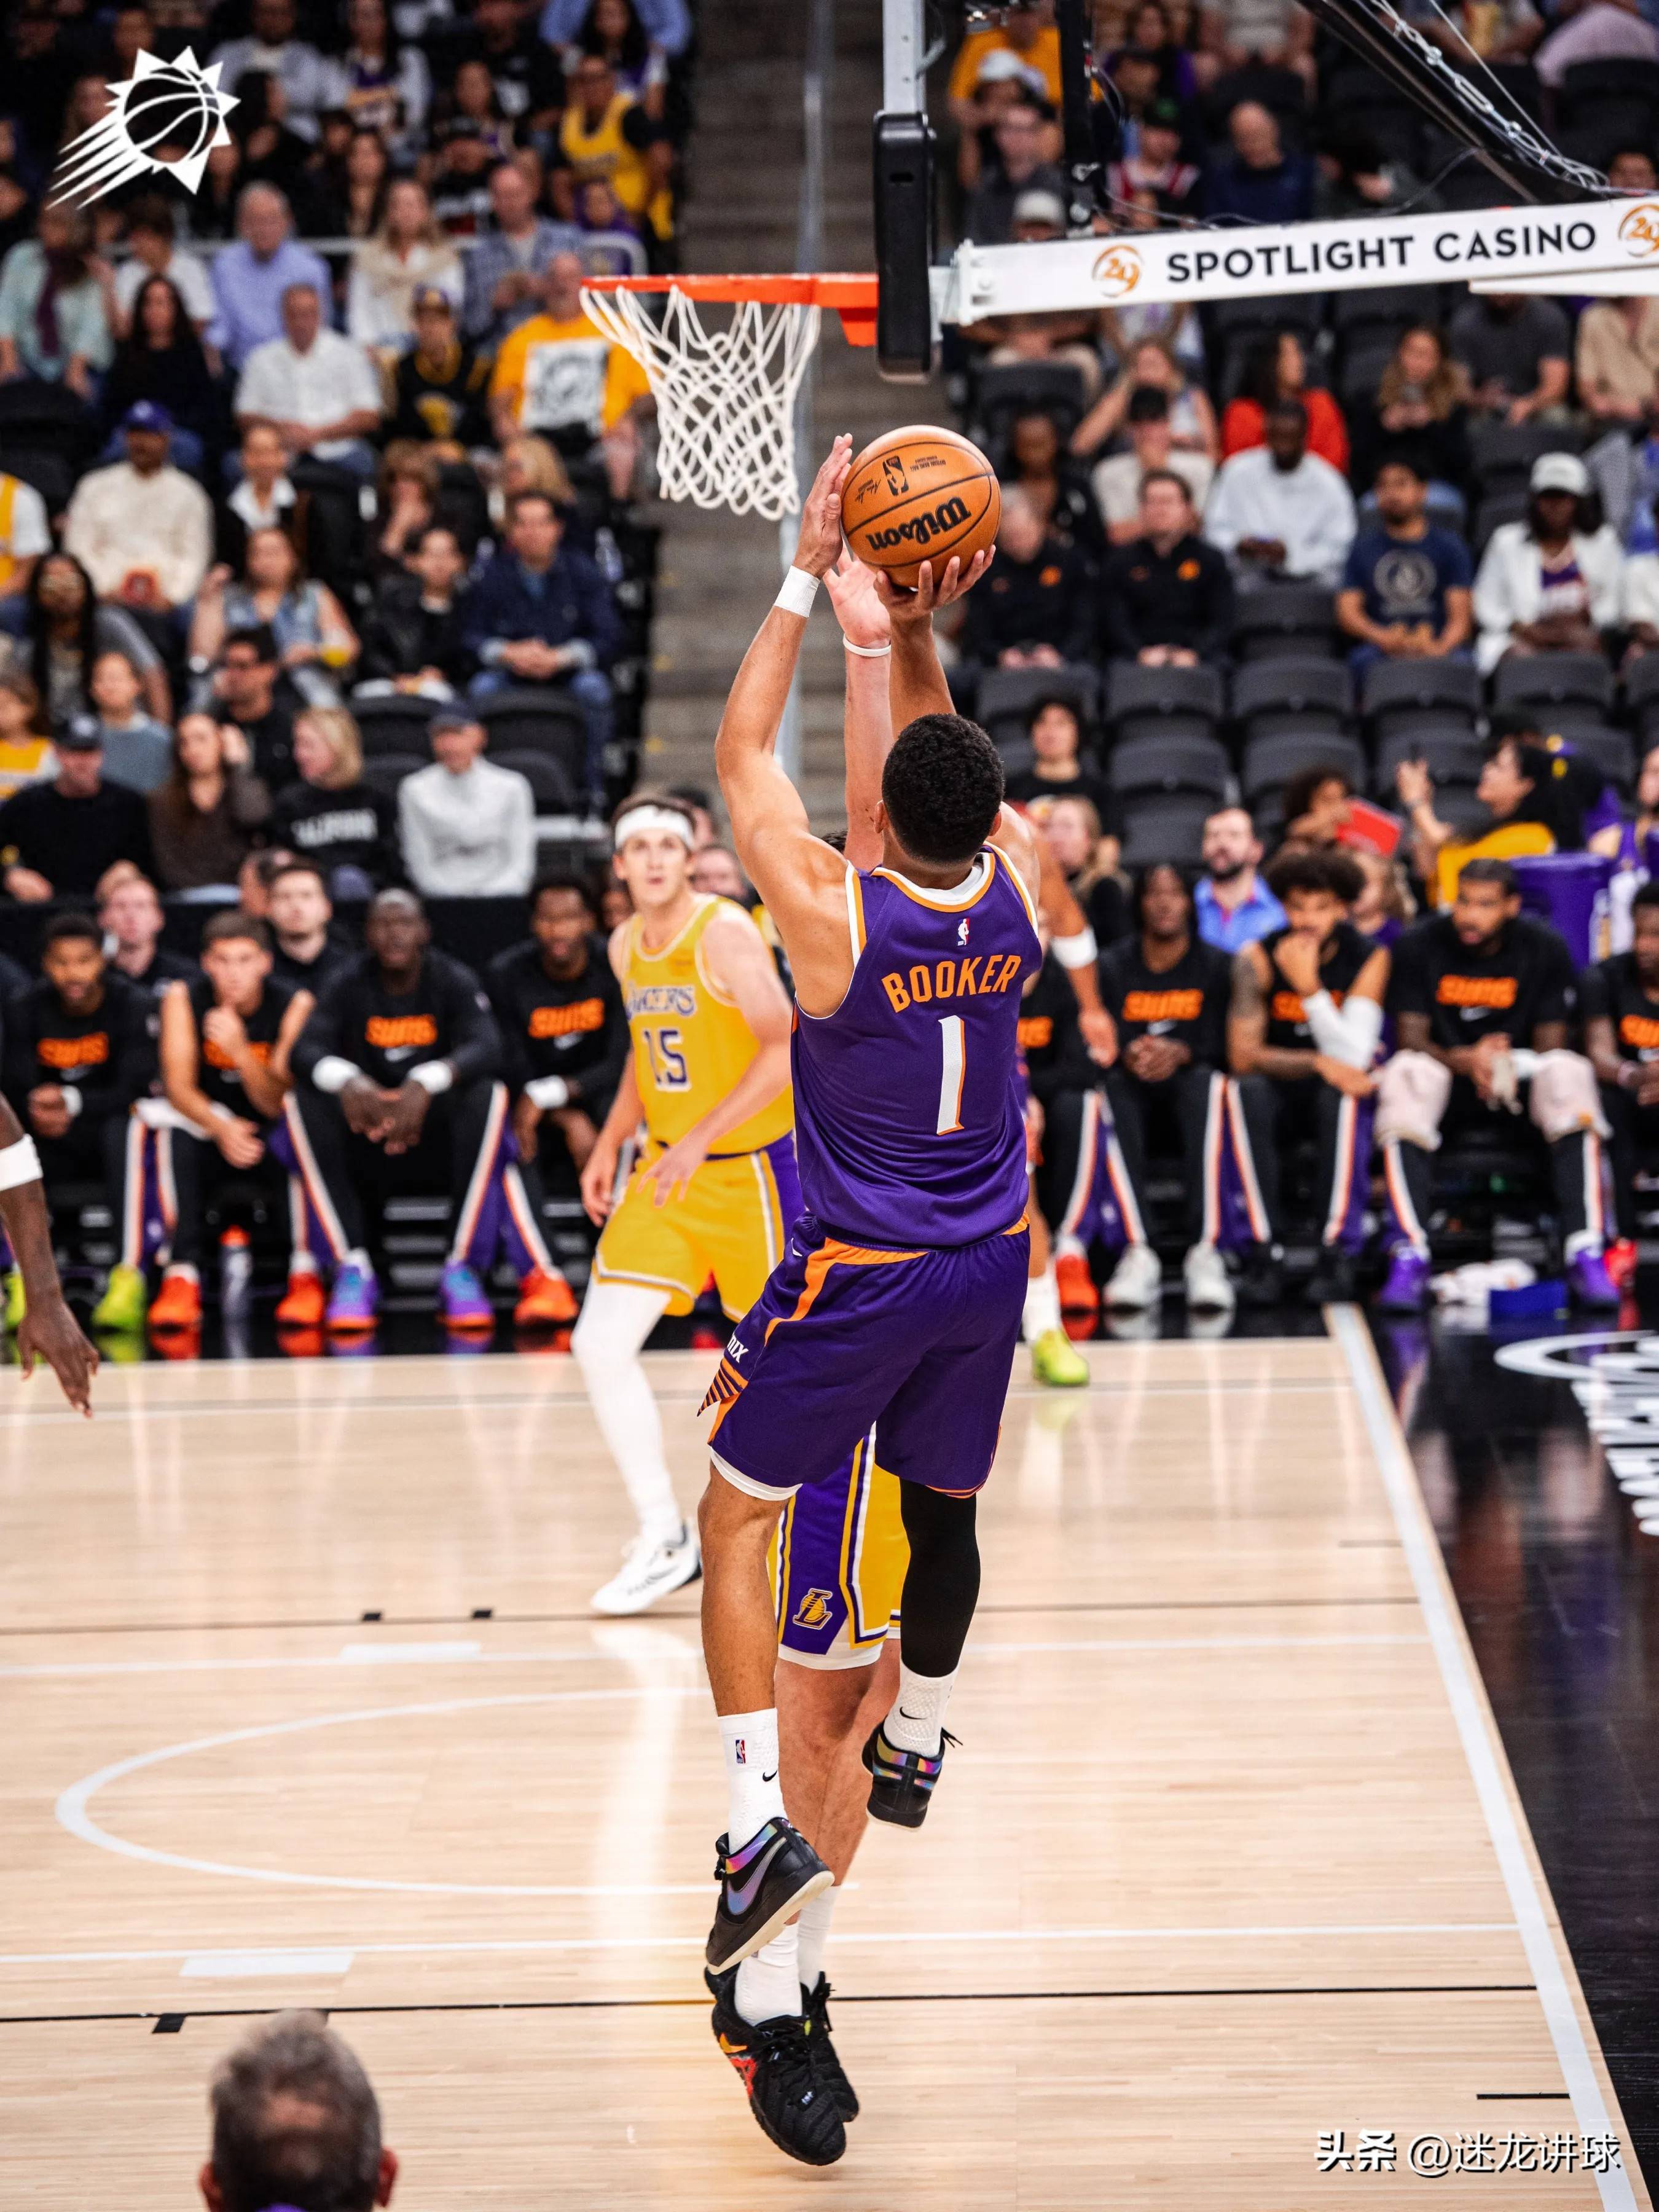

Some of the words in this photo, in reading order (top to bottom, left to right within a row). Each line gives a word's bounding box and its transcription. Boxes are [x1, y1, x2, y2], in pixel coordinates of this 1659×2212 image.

[1167, 236, 1413, 283] SPOTLIGHT
[1434, 222, 1596, 262] CASINO
[865, 496, 971, 551] Wilson
[881, 954, 1021, 1013] BOOKER
[642, 1027, 692, 1092] 15
[936, 1015, 965, 1135] 1
